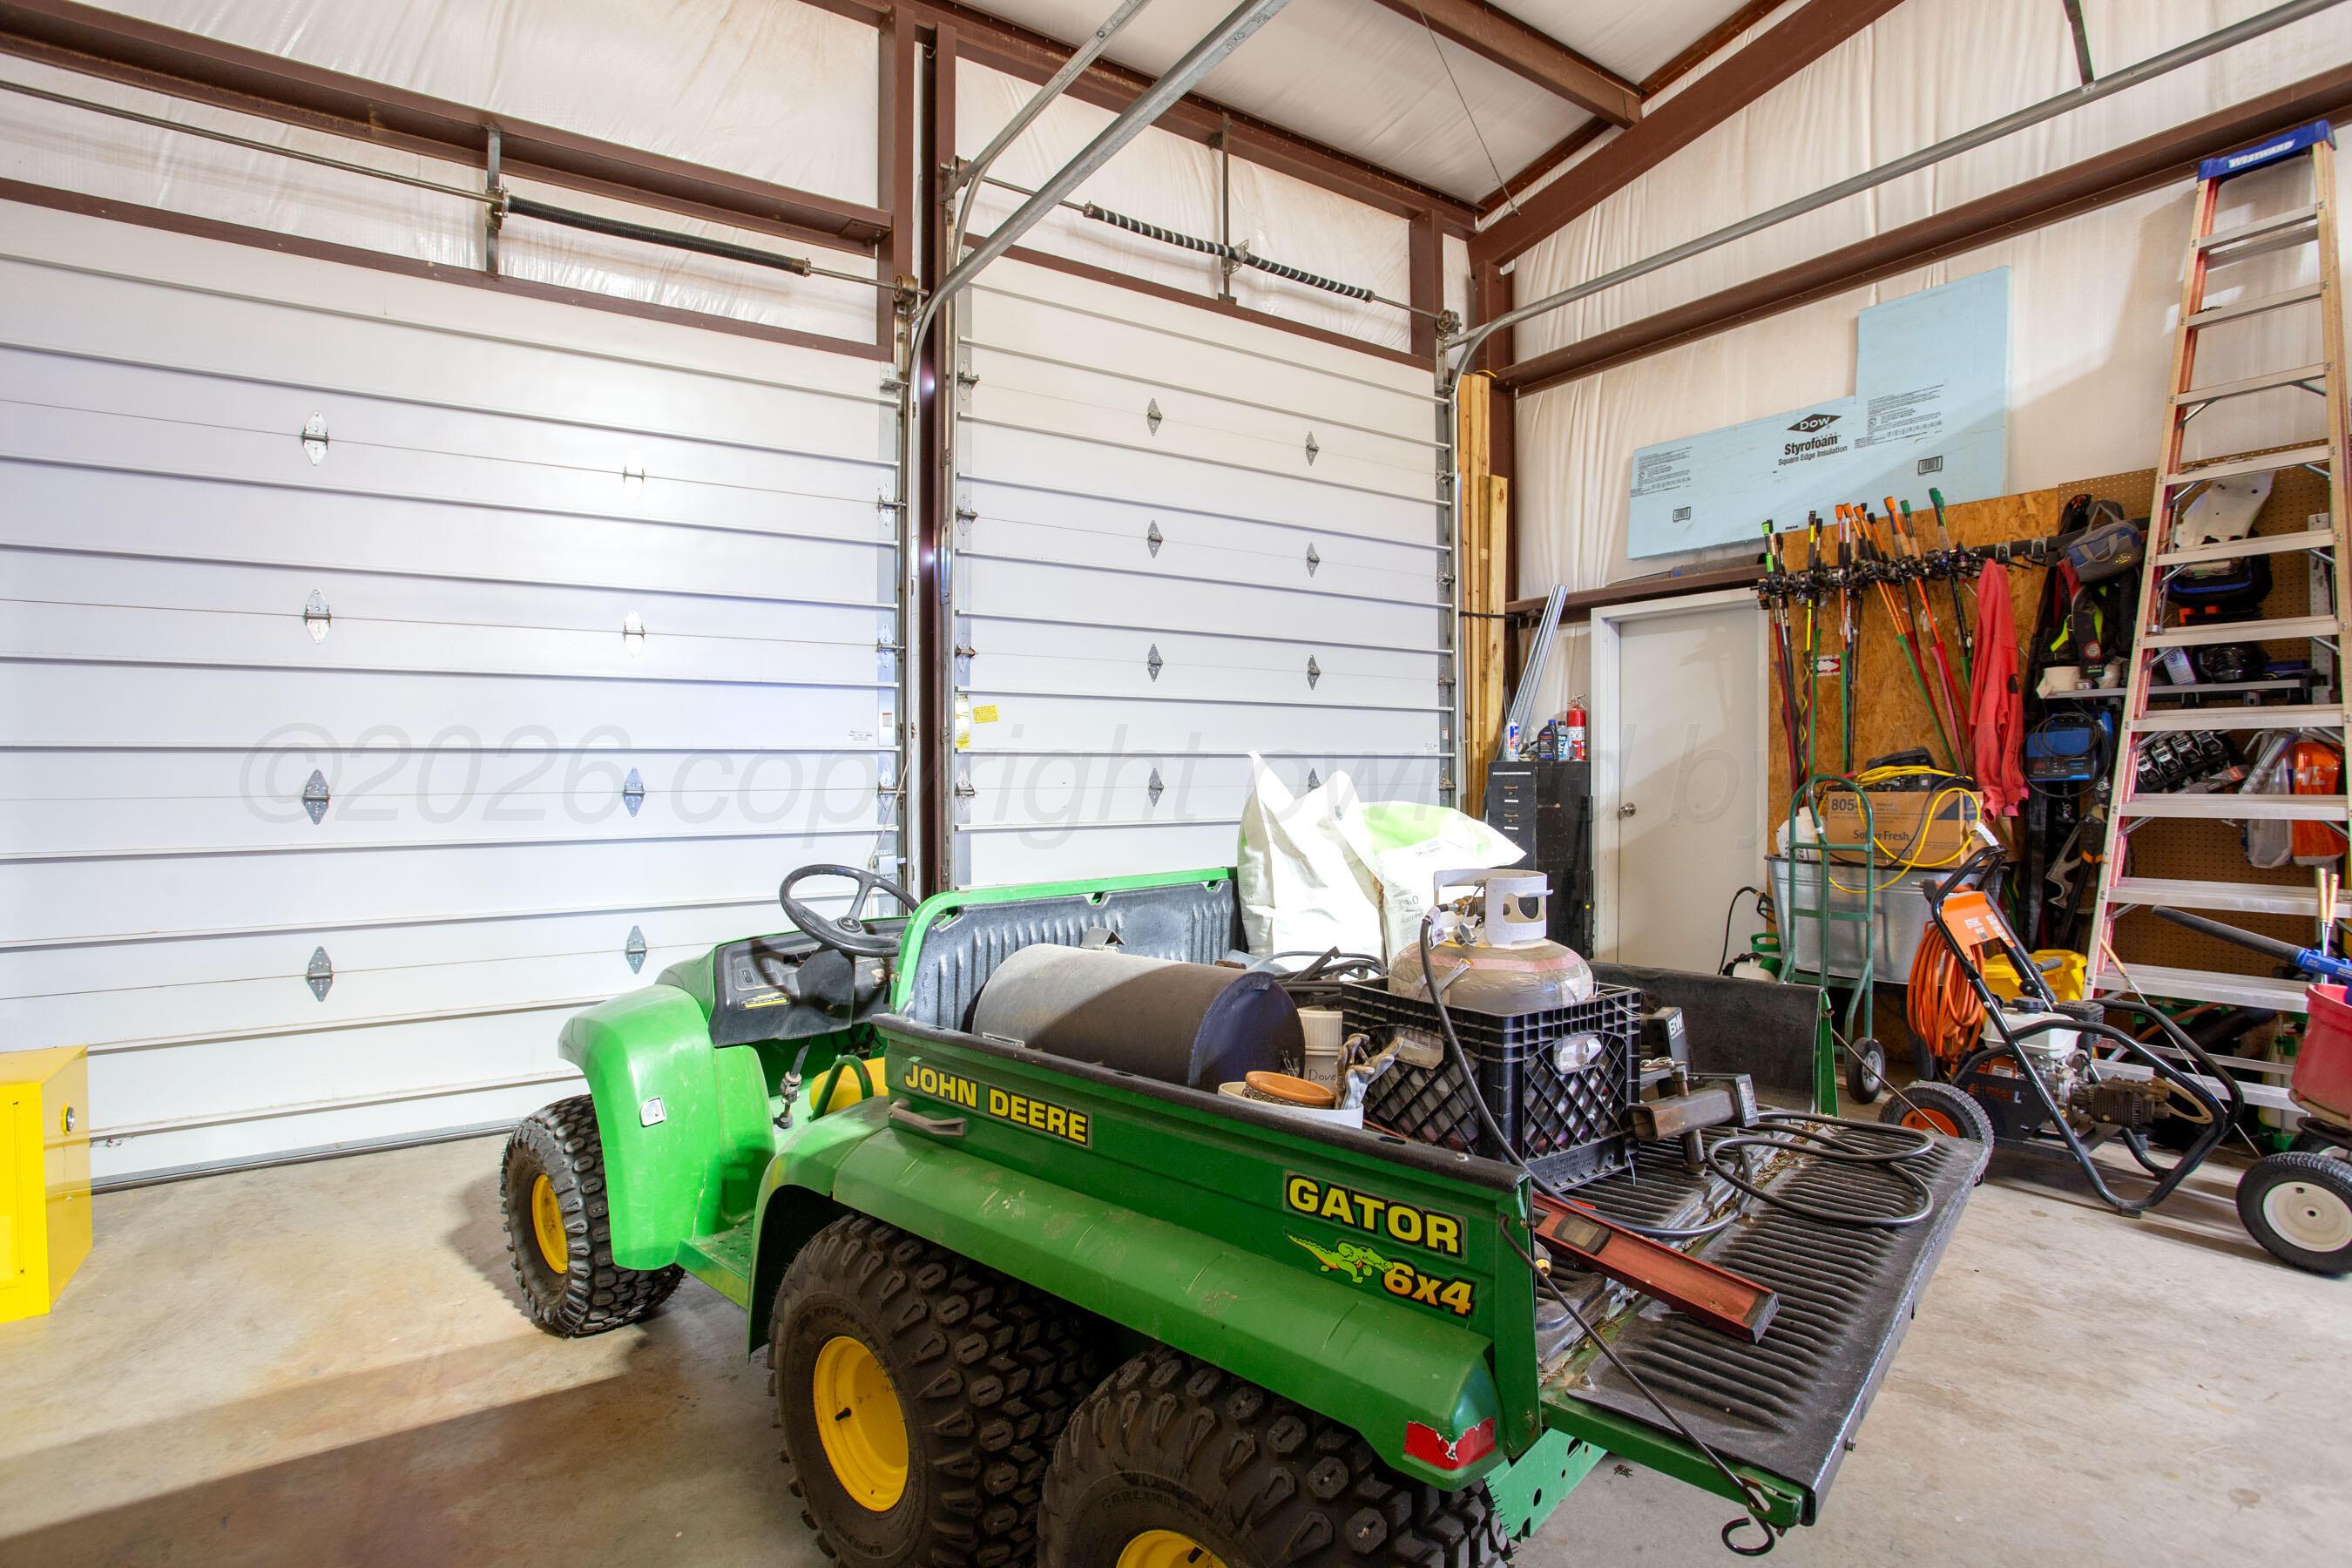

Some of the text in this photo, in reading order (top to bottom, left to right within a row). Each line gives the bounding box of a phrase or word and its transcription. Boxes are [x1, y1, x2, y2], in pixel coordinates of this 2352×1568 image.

[2228, 139, 2296, 168] WESTWARD
[1799, 416, 1831, 430] DOW
[1778, 445, 1848, 466] Square Edge Insulation
[1784, 435, 1838, 456] Styrofoam
[904, 1064, 1087, 1143] JOHN DEERE
[1288, 1176, 1460, 1255] GATOR
[1382, 1261, 1473, 1315] 6x4
